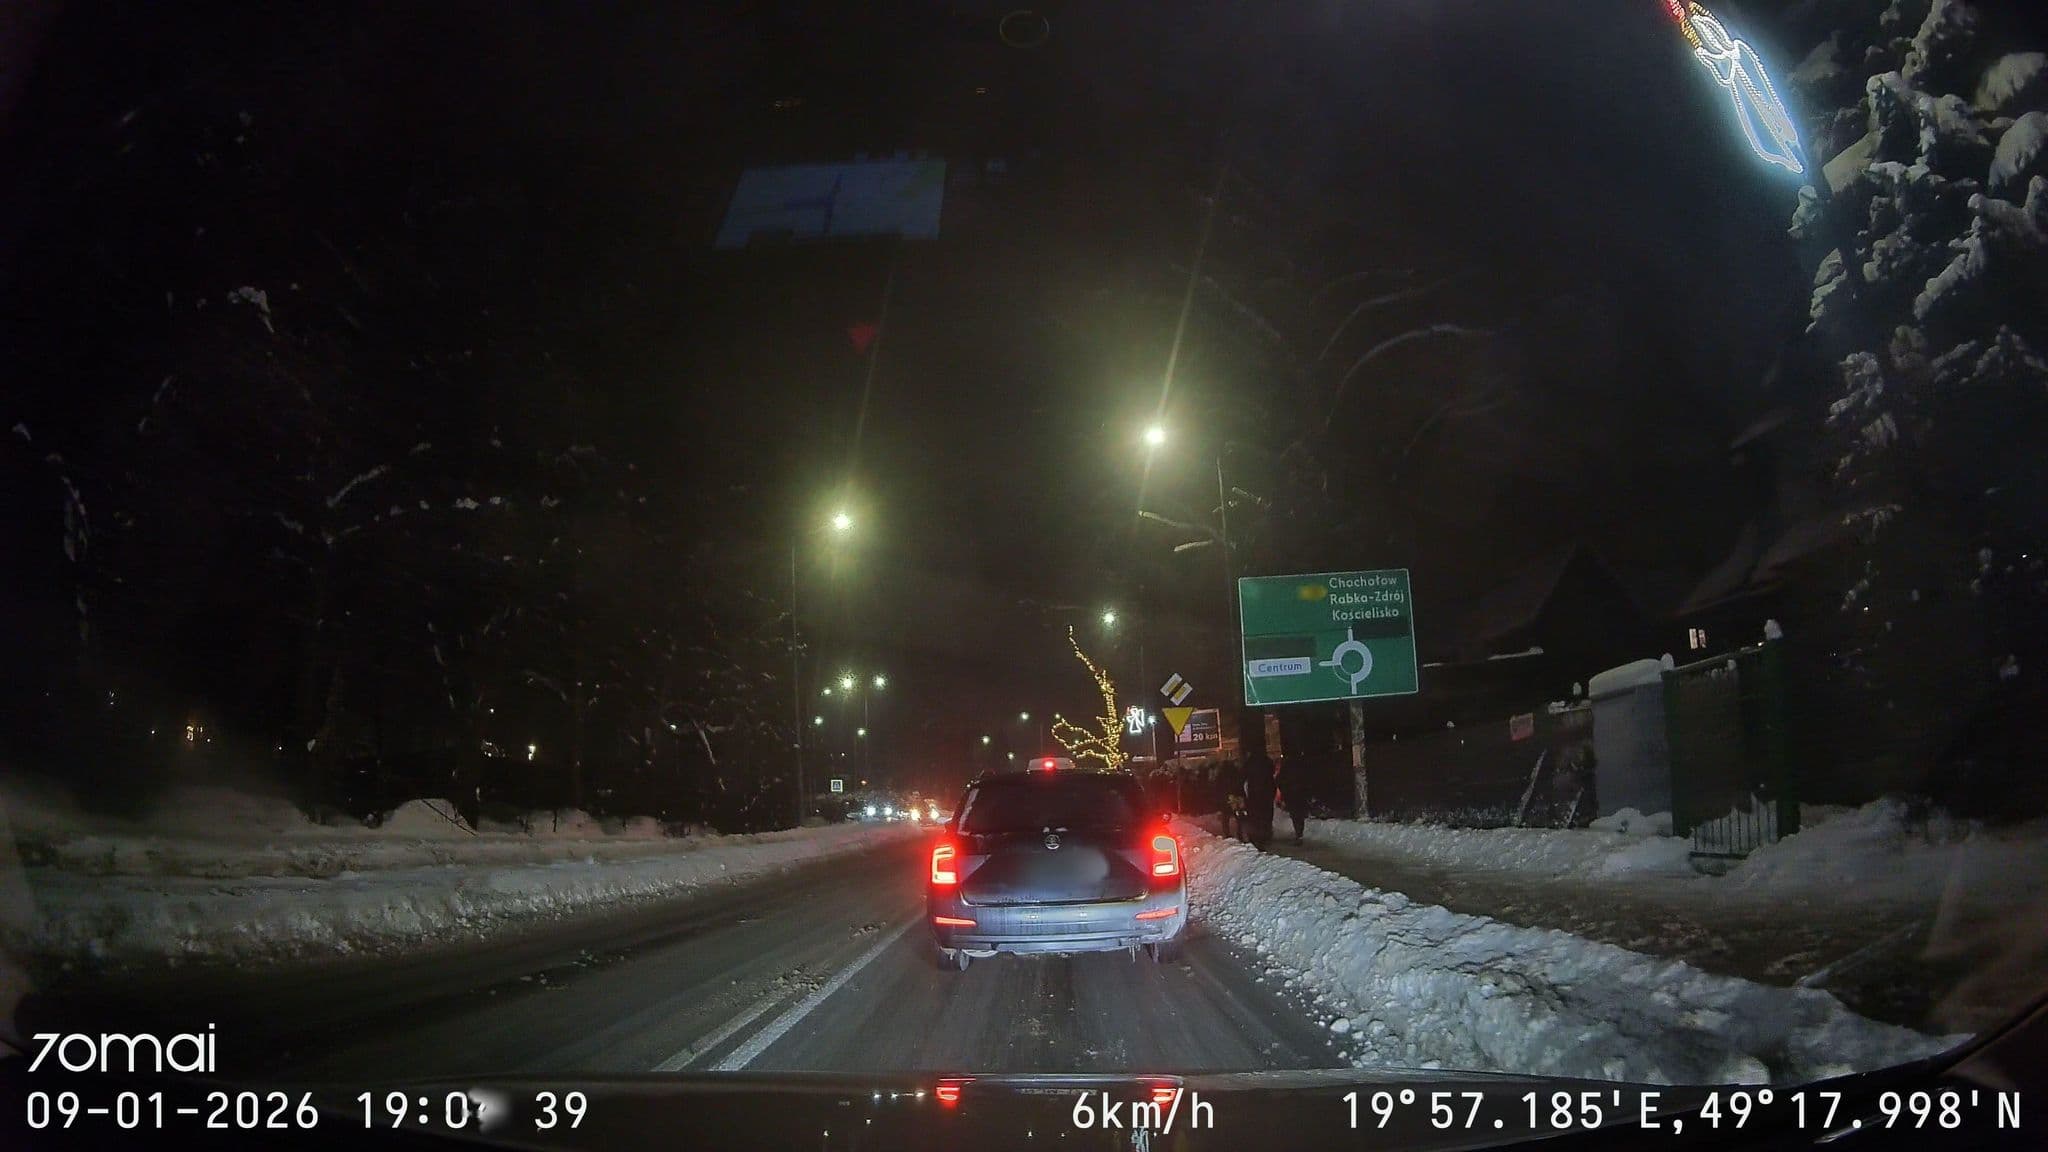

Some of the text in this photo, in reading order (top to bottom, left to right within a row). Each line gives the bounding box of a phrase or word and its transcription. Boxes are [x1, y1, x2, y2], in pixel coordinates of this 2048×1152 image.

[1330, 590, 1404, 604] Rabka-Zdrój
[1258, 663, 1303, 673] Centrum
[1193, 733, 1204, 741] 20
